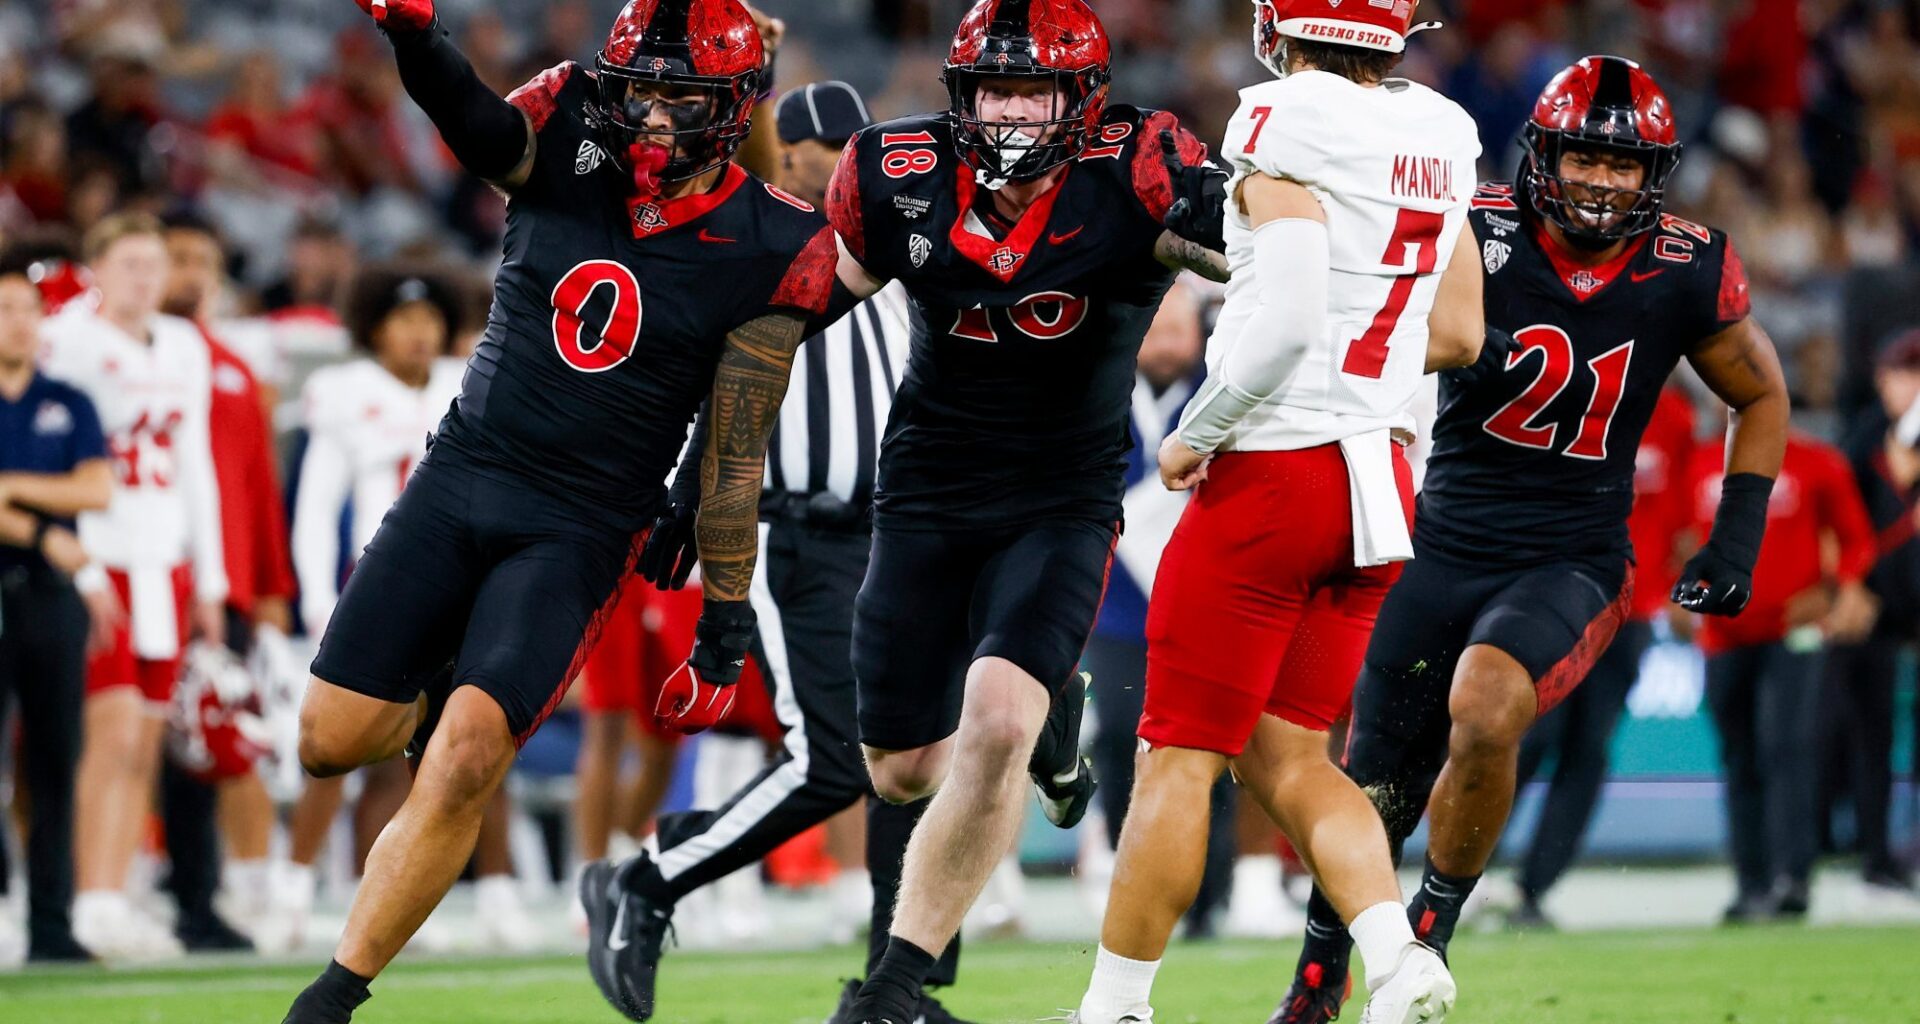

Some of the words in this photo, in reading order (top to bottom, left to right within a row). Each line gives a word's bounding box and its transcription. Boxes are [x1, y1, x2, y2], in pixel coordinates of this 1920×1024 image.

[1301, 23, 1355, 40] FRESNO
[1357, 31, 1393, 47] STATE
[1243, 106, 1272, 154] 7
[881, 130, 938, 179] 18
[1391, 154, 1458, 202] MANDAL
[893, 195, 931, 208] Palomar
[1654, 235, 1693, 263] C
[551, 259, 642, 373] 0
[1341, 208, 1445, 379] 7
[1482, 324, 1634, 460] 21
